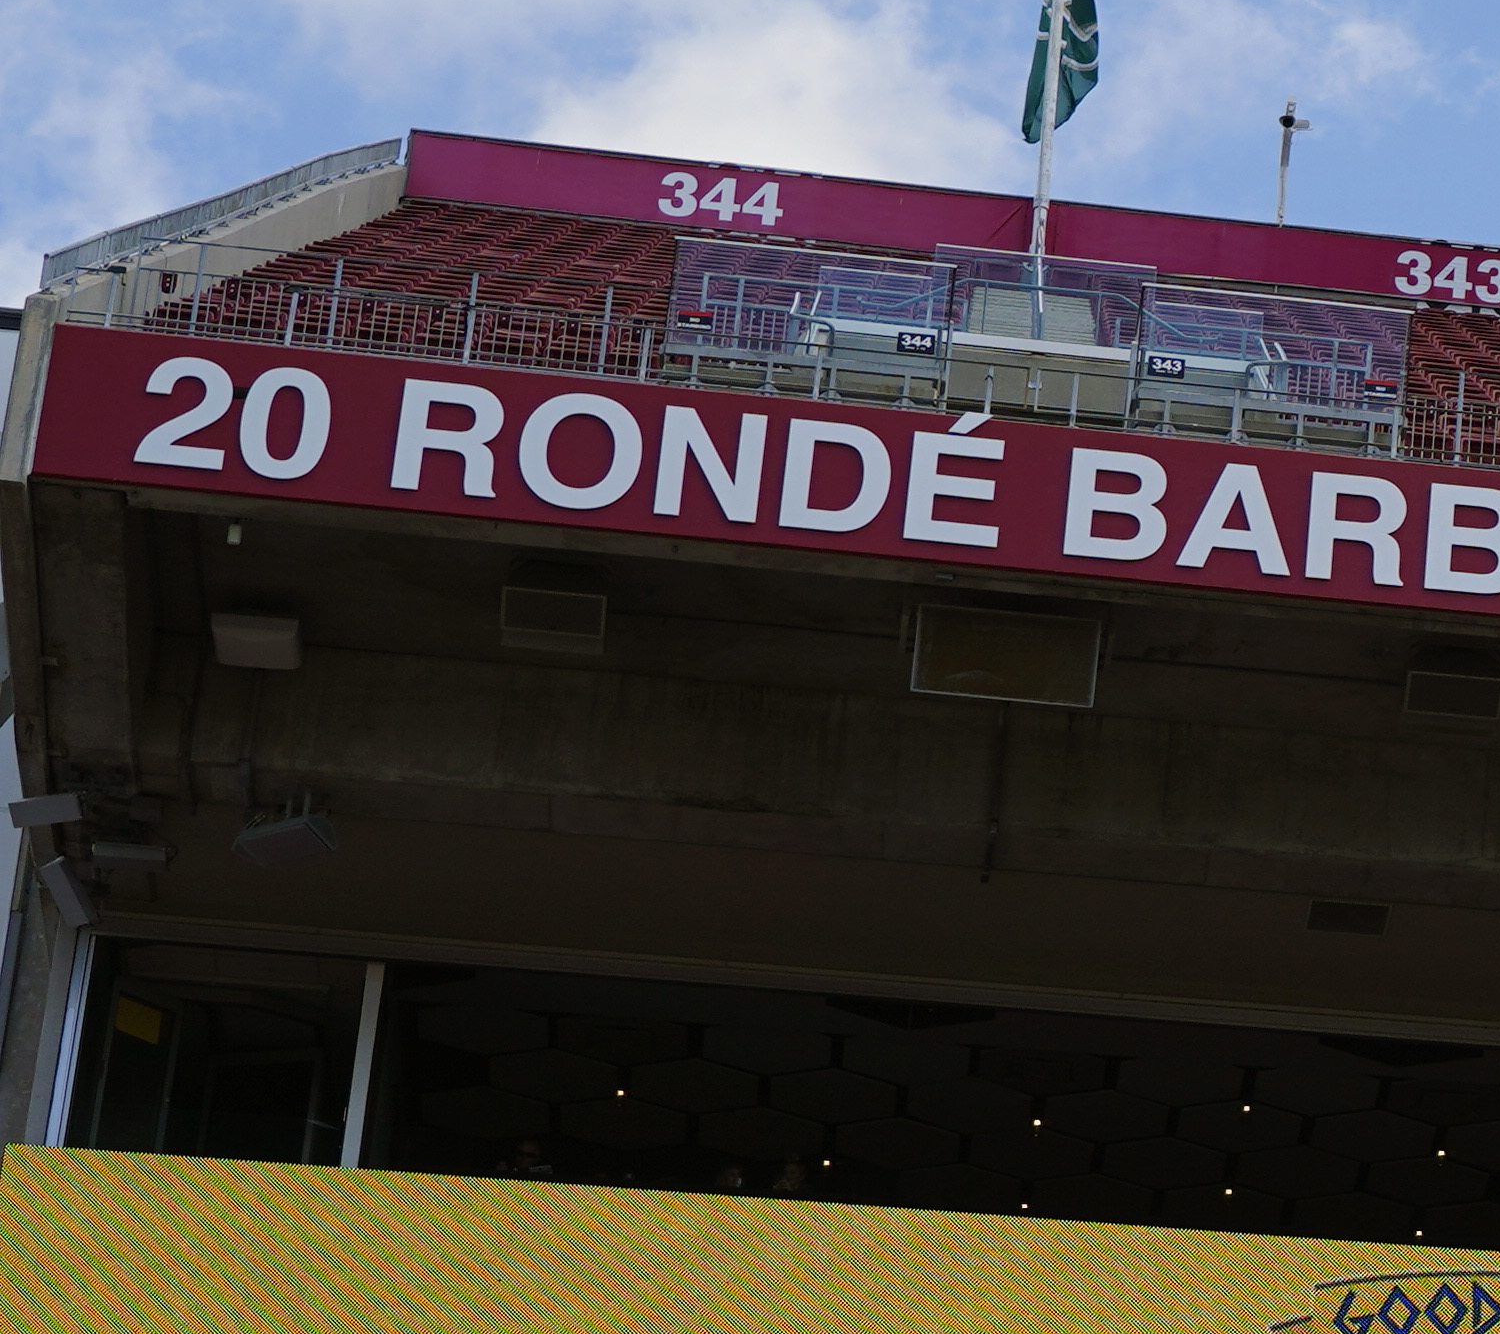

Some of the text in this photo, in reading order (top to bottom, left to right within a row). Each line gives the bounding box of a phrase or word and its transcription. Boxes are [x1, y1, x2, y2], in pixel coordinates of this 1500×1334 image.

[658, 171, 784, 226] 344
[901, 334, 932, 349] 344
[1152, 357, 1183, 373] 343
[133, 356, 331, 479] 20
[390, 378, 1007, 548] RONDÉ
